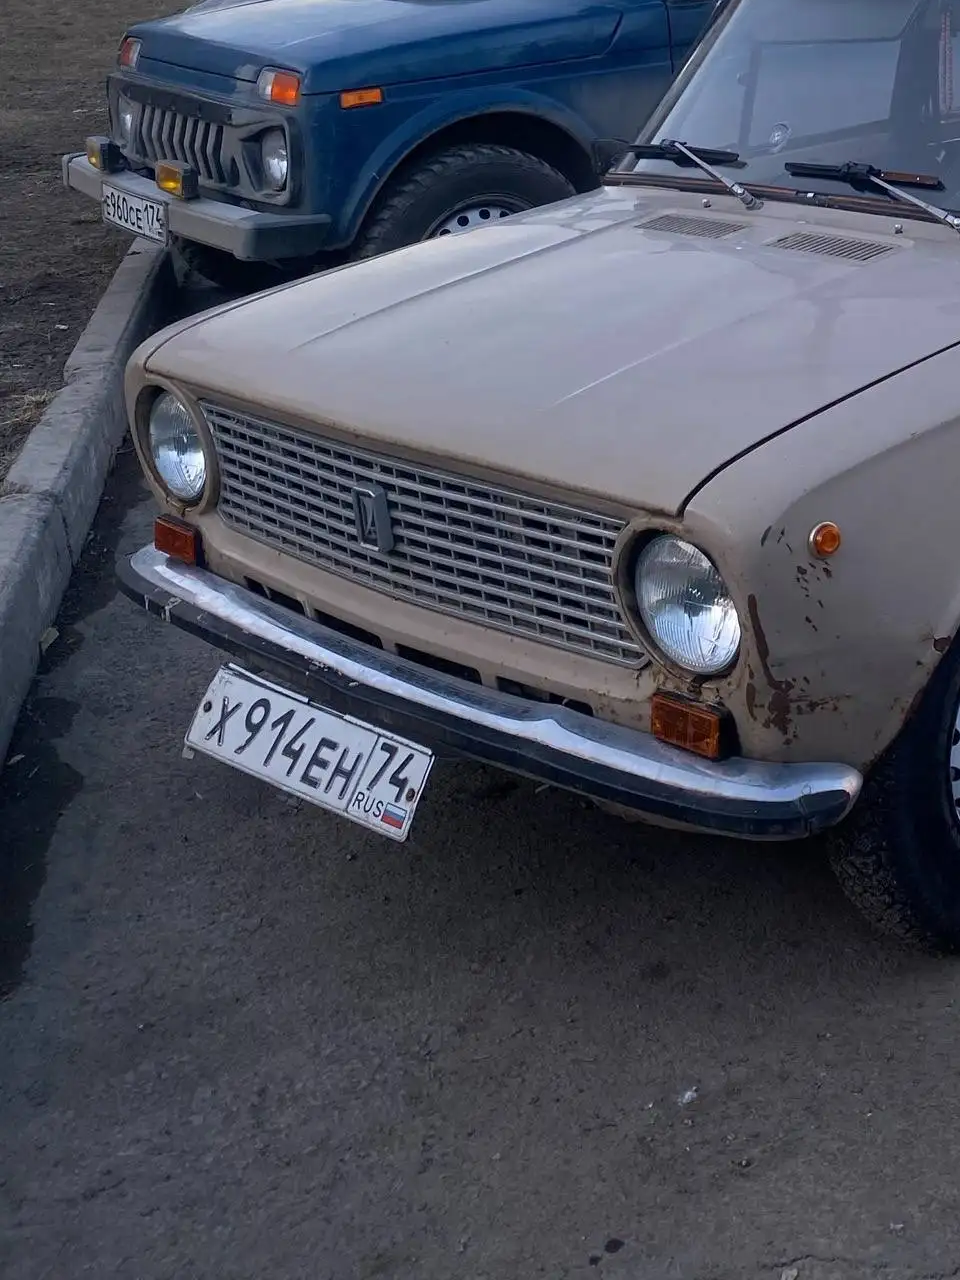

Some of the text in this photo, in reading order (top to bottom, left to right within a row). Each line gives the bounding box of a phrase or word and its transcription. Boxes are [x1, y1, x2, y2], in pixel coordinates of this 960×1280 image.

[204, 696, 415, 803] Х914ЕН 74
[352, 791, 385, 819] RUS
